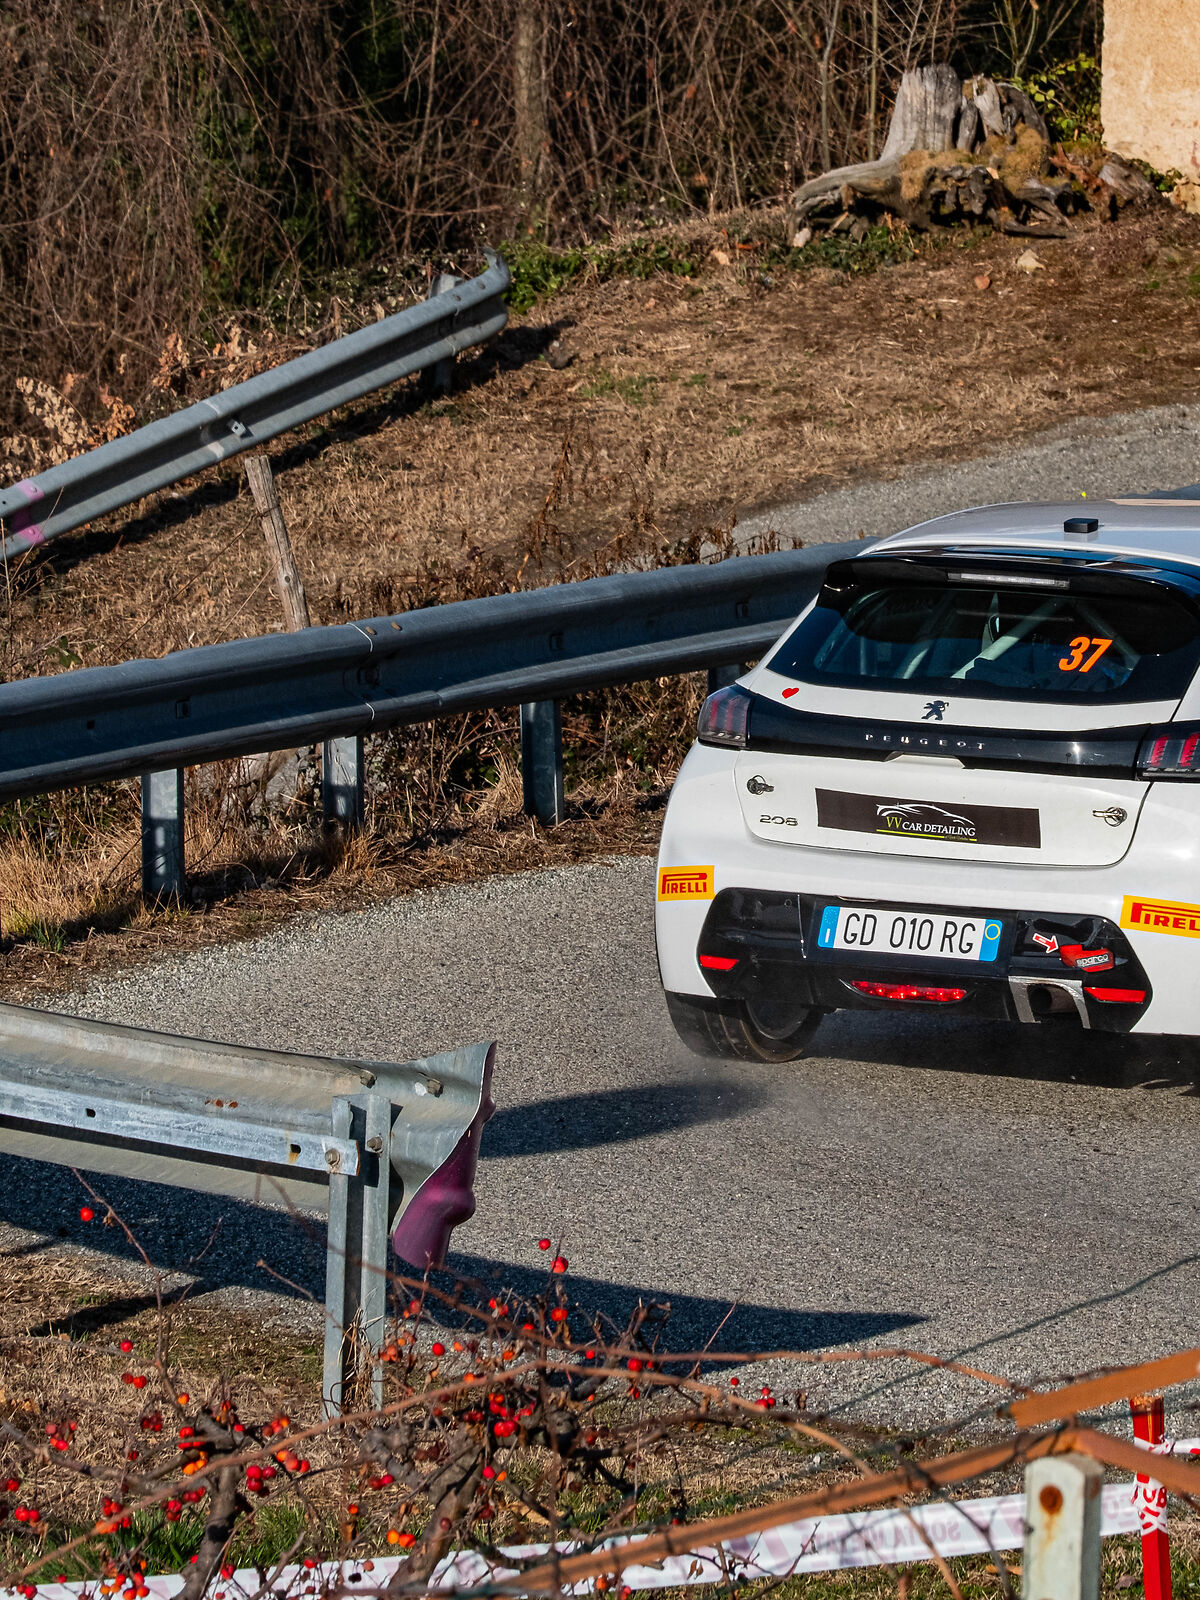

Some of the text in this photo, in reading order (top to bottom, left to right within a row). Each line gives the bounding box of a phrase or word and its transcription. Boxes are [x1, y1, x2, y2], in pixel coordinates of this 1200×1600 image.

[1058, 636, 1113, 673] 37
[864, 733, 986, 751] PEUGEOT
[759, 814, 799, 827] 208
[902, 821, 922, 832] CAR
[923, 823, 977, 836] DETAILING
[661, 872, 708, 895] PIRELLI
[843, 912, 976, 954] GD 010 RG
